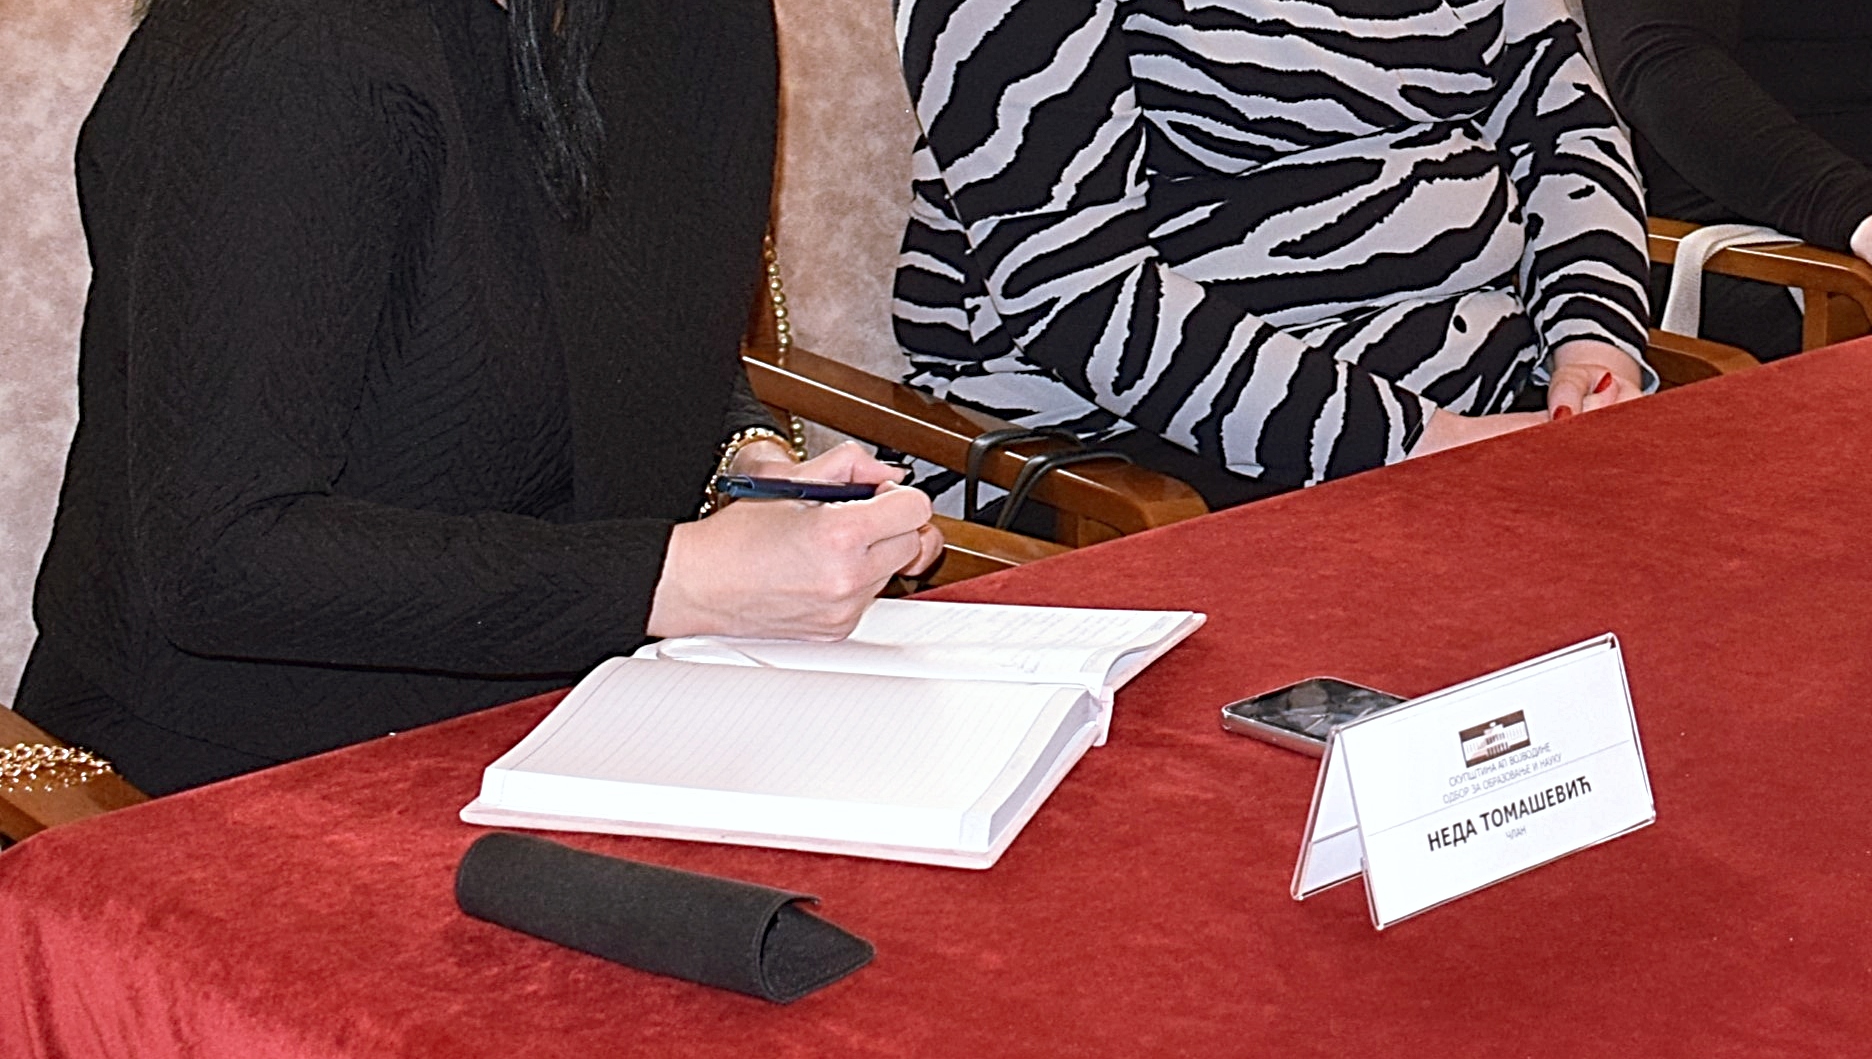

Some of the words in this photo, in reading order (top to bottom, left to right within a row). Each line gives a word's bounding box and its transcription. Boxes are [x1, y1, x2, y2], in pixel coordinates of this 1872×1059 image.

[1497, 758, 1508, 770] АП
[1509, 742, 1552, 766] ВОЈВОДИНЕ
[1442, 788, 1470, 804] ОДБОР
[1472, 783, 1481, 794] ЗА
[1482, 764, 1531, 790] ОБРАЗОВАЊЕ
[1539, 753, 1562, 769] НАУКУ
[1427, 818, 1478, 852] НЕДА
[1479, 775, 1592, 832] ТОМАШЕВИЋ
[1505, 825, 1527, 840] ЧЛАН
